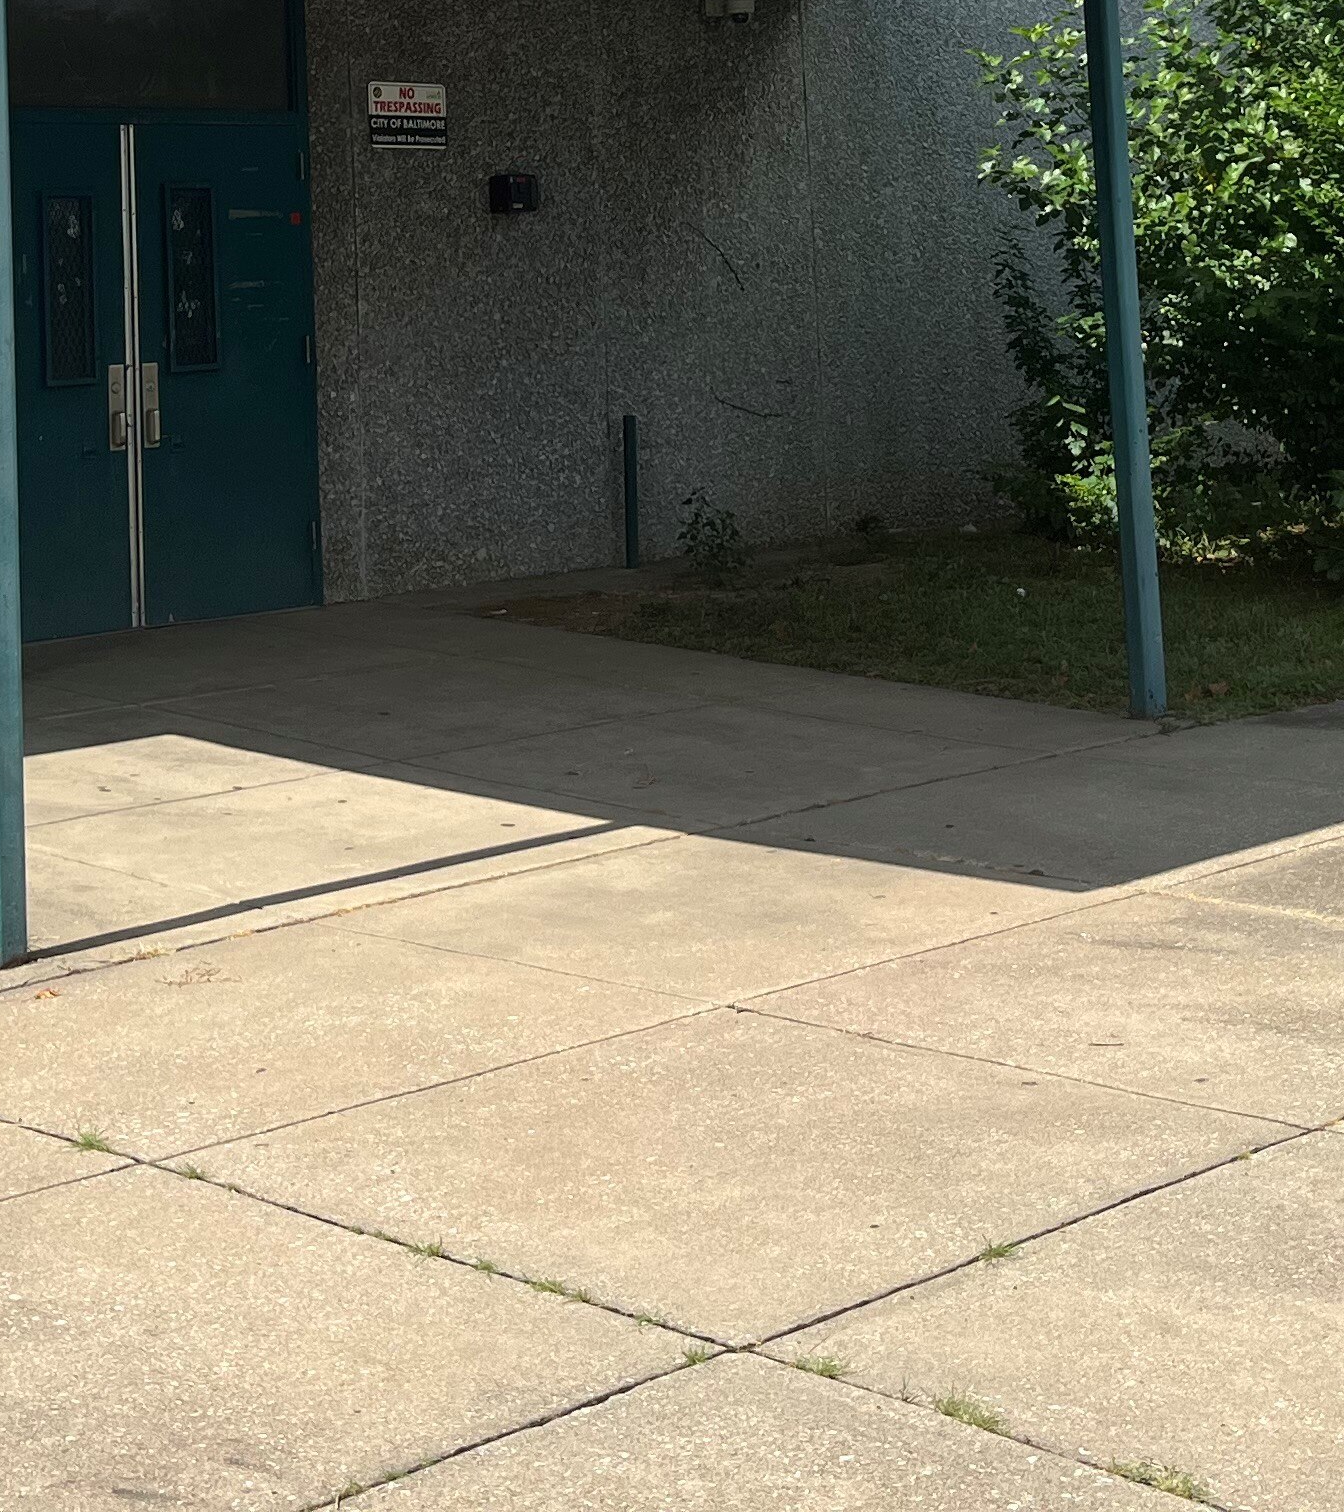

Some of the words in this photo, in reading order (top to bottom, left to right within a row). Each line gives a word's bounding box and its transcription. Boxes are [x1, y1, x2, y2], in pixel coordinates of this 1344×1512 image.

[399, 87, 415, 99] NO
[373, 101, 441, 114] TRESPASSING
[371, 118, 389, 128] CITY
[390, 118, 402, 128] OF
[403, 119, 445, 130] BALTIMORE
